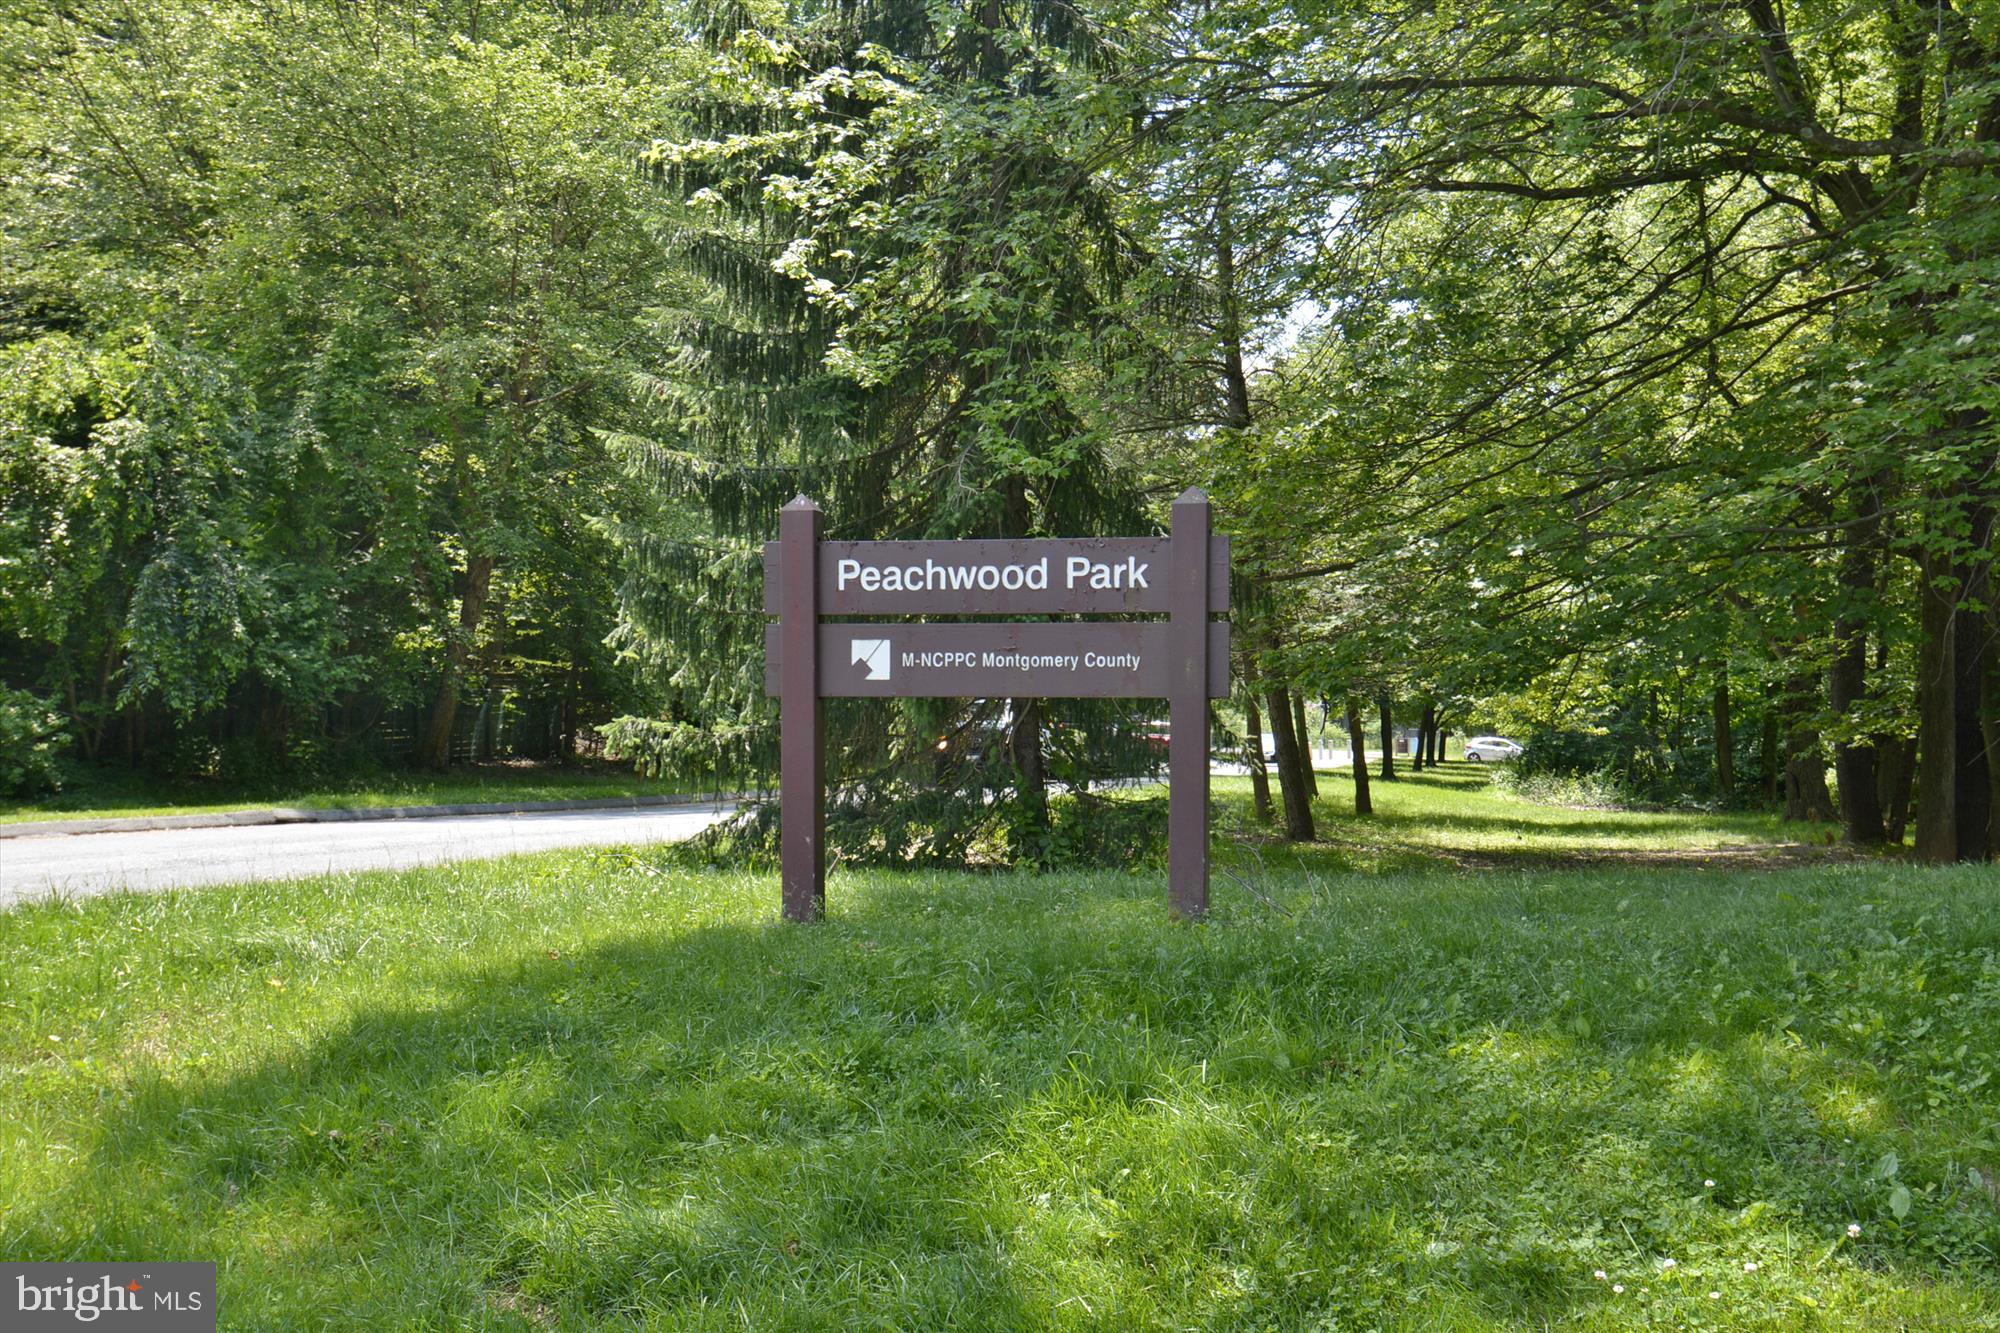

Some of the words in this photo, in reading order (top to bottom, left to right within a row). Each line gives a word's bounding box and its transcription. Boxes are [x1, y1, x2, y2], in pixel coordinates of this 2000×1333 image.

[838, 556, 1048, 592] Peachwood
[1066, 555, 1149, 590] Park
[902, 651, 977, 668] M-NCPPC
[982, 652, 1079, 672] Montgomery
[1084, 651, 1141, 672] County
